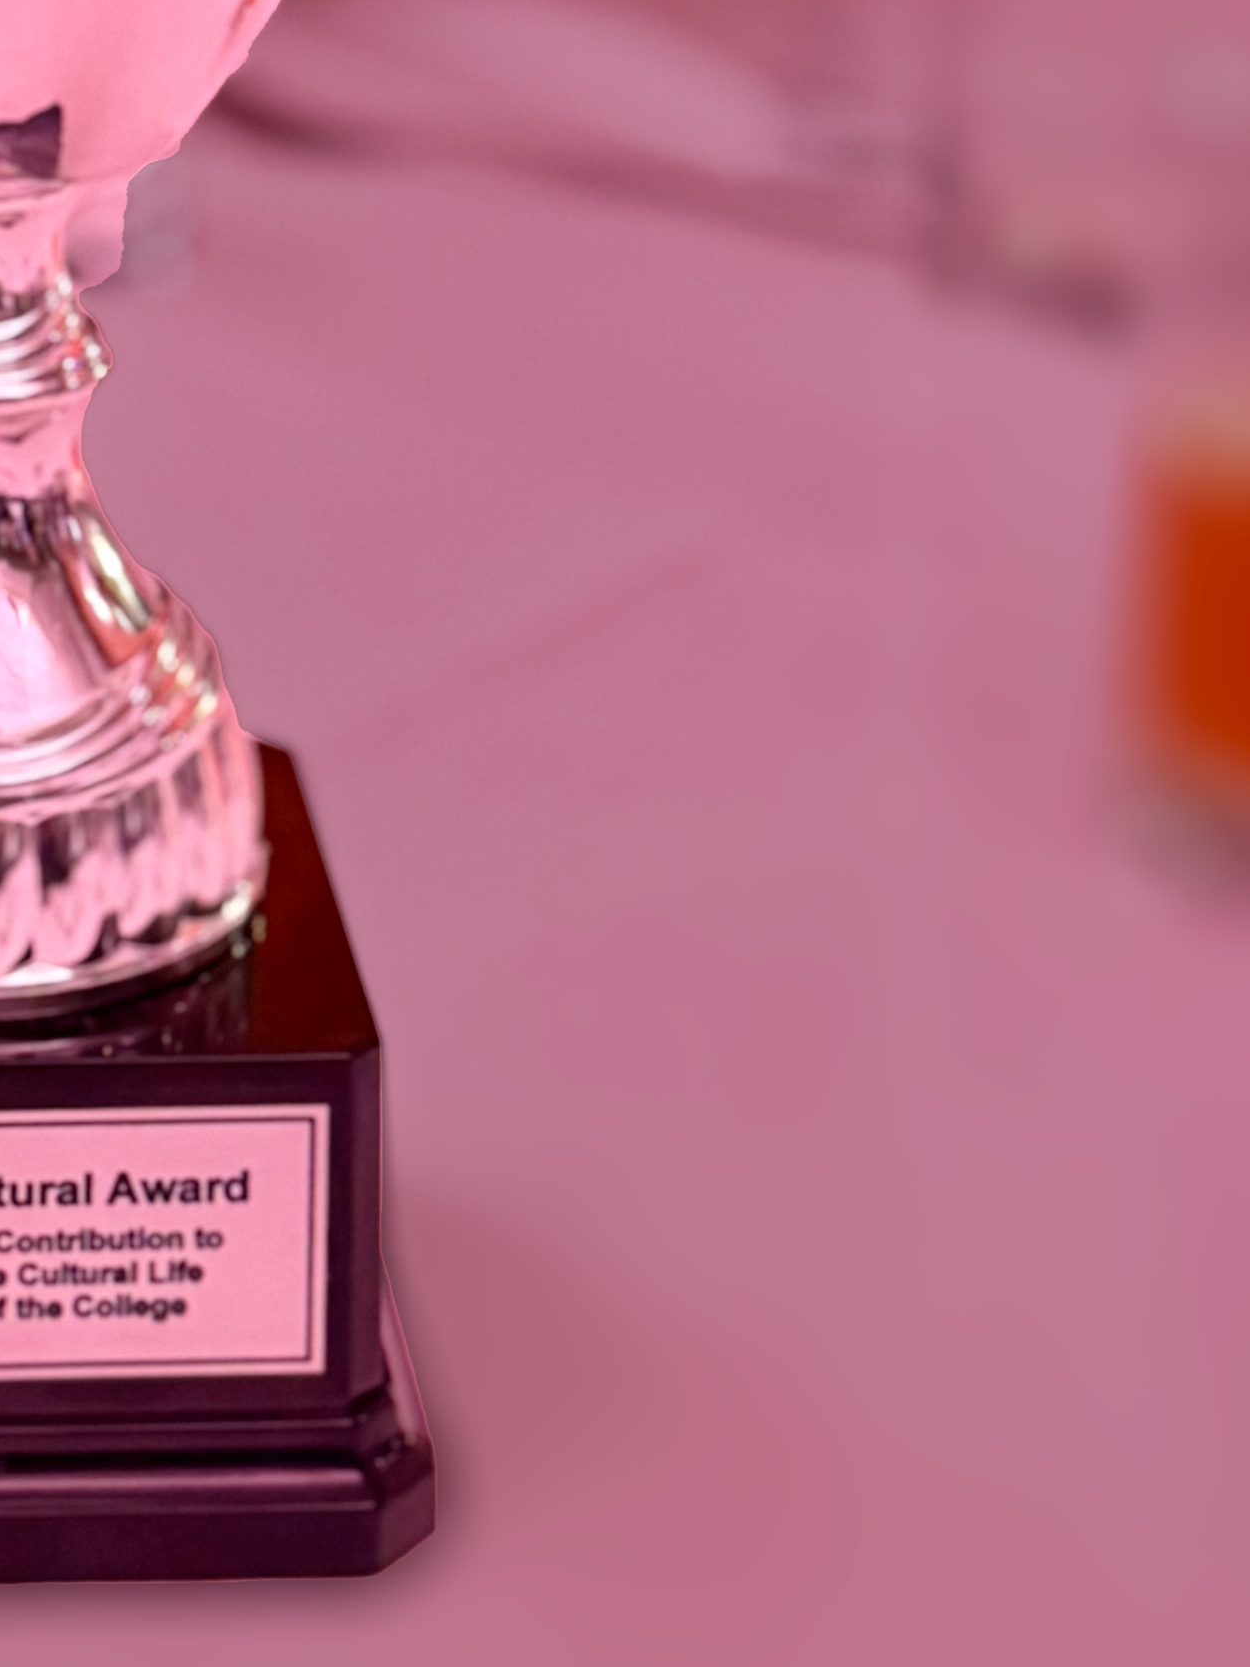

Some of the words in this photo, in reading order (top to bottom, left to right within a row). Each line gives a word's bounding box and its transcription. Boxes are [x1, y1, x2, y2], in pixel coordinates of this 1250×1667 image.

[105, 1168, 252, 1207] Award
[193, 1226, 226, 1252] to
[16, 1259, 139, 1288] Cultural
[148, 1258, 206, 1285] Life
[15, 1295, 64, 1321] the
[71, 1292, 189, 1325] College
